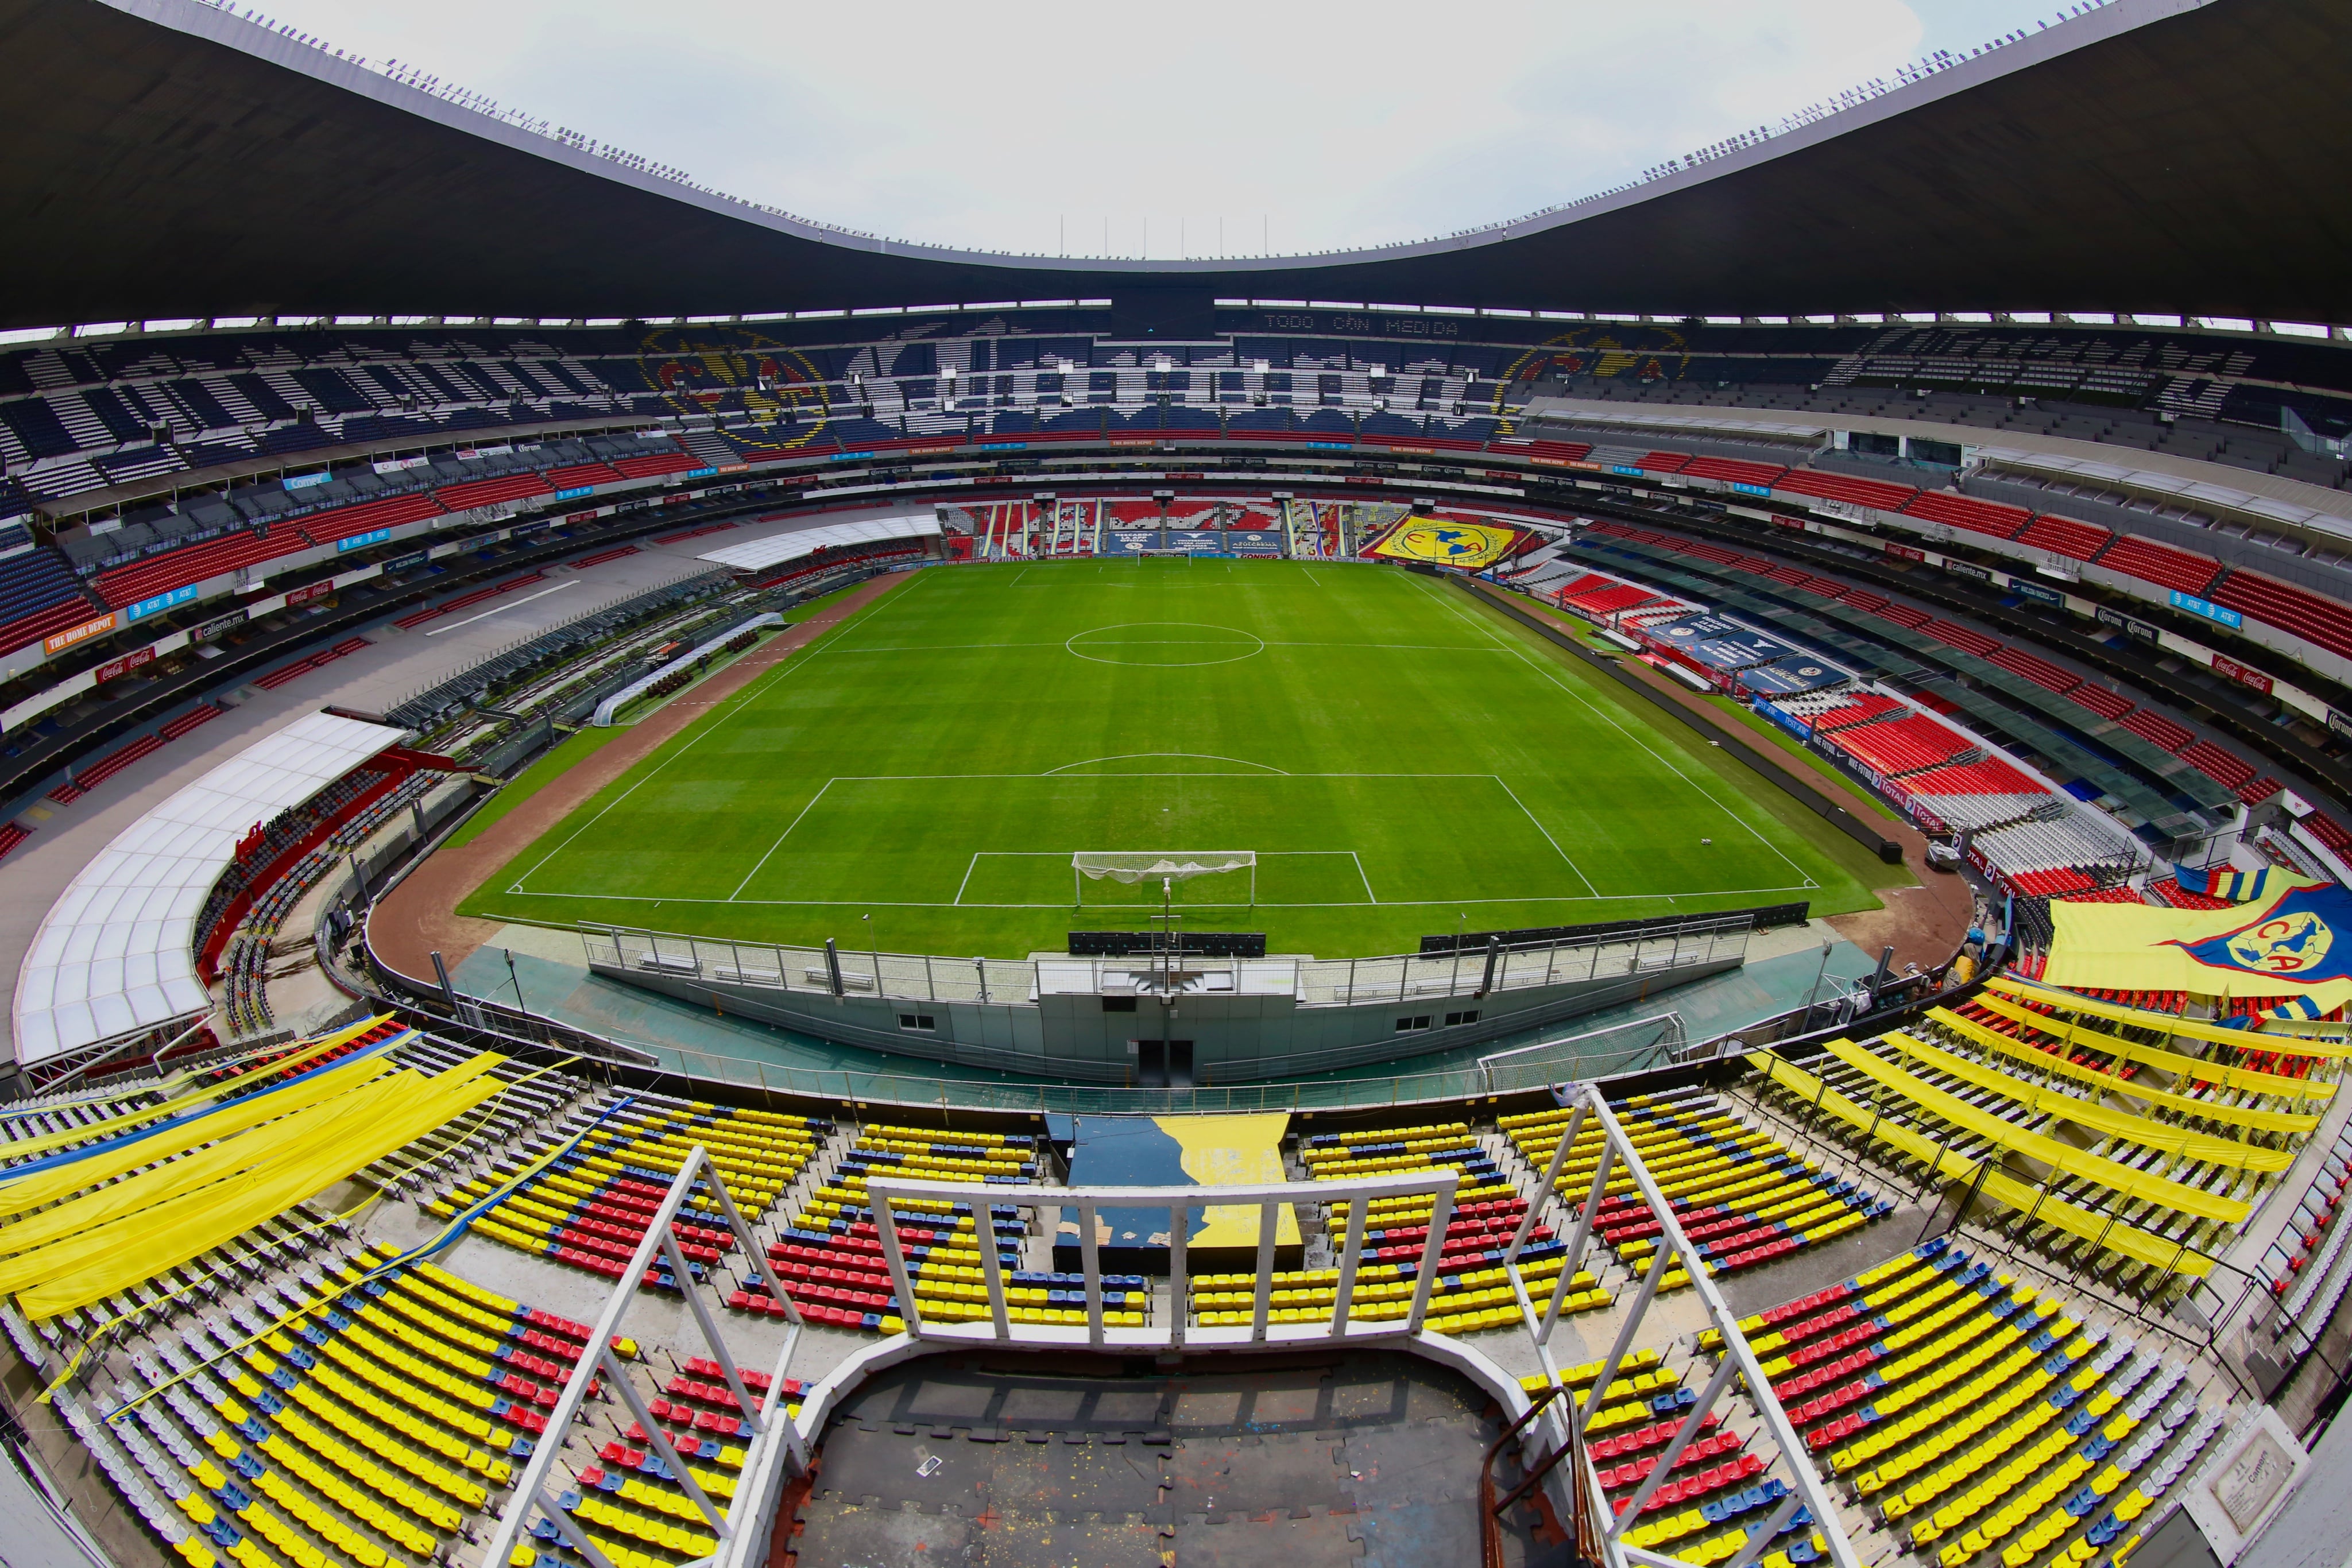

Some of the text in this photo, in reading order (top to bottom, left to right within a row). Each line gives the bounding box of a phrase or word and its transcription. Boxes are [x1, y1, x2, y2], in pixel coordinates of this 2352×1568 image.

[1265, 315, 1313, 328] TODO
[1386, 320, 1458, 335] MEDIDA
[291, 474, 323, 489] Comex
[1888, 545, 1902, 555] Coca-Cola
[1905, 549, 1920, 560] Coca-Cola
[1953, 563, 1986, 580] caliente.mx
[179, 587, 192, 598] AT&T
[291, 590, 307, 603] Coca-Cola
[312, 582, 330, 597] Coca-Cola
[147, 599, 160, 610] AT&T
[1566, 603, 1589, 619] caliente.mx
[2187, 599, 2201, 610] AT&T
[203, 614, 244, 637] caliente.mx
[1701, 616, 1734, 630] DESCARGA
[2098, 609, 2122, 627] Corona
[2220, 611, 2235, 623] AT&T
[49, 616, 113, 649] THE HOME DEPOT
[2127, 620, 2152, 638] Corona
[130, 650, 150, 668] Coca-Cola
[2216, 659, 2238, 676] Coca-Cola
[103, 663, 123, 680] Coca-Cola
[2243, 672, 2266, 690] Coca-Cola
[2329, 713, 2352, 739] Corona
[1813, 734, 1835, 755] NIKE FUTBOL
[1848, 757, 1873, 781] NIKE FUTBOL
[1881, 779, 1905, 805] TOTAL
[1916, 806, 1940, 831] TOTAL
[2248, 1450, 2268, 1484] Camera
